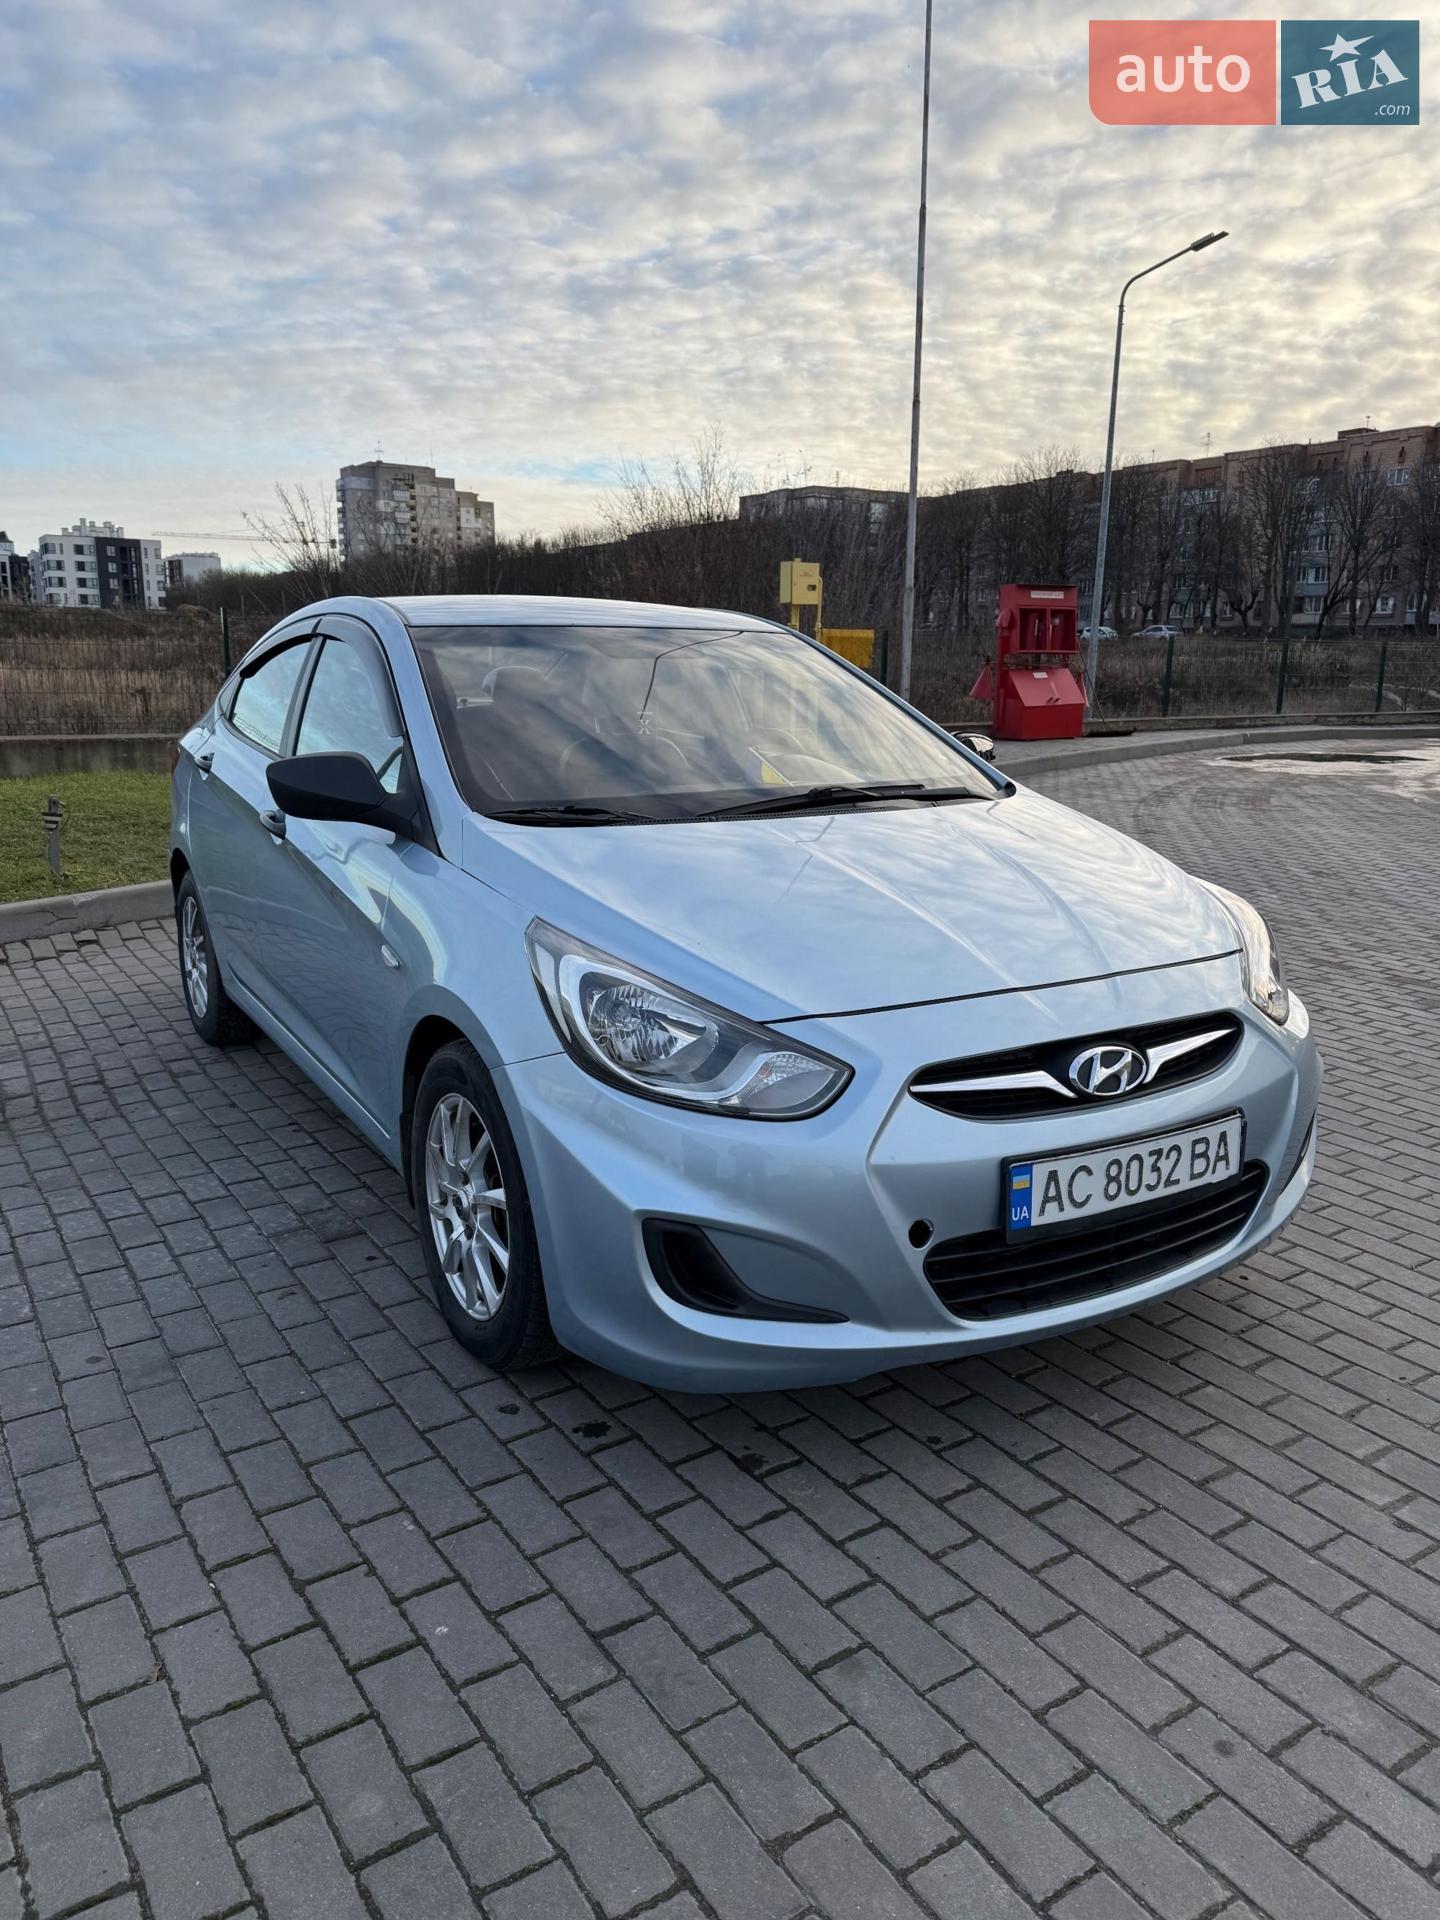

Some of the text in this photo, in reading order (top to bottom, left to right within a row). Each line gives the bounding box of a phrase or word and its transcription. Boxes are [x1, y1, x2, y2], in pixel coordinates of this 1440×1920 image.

[1038, 1130, 1230, 1217] AC 8032 BA
[1011, 1206, 1029, 1221] UA
